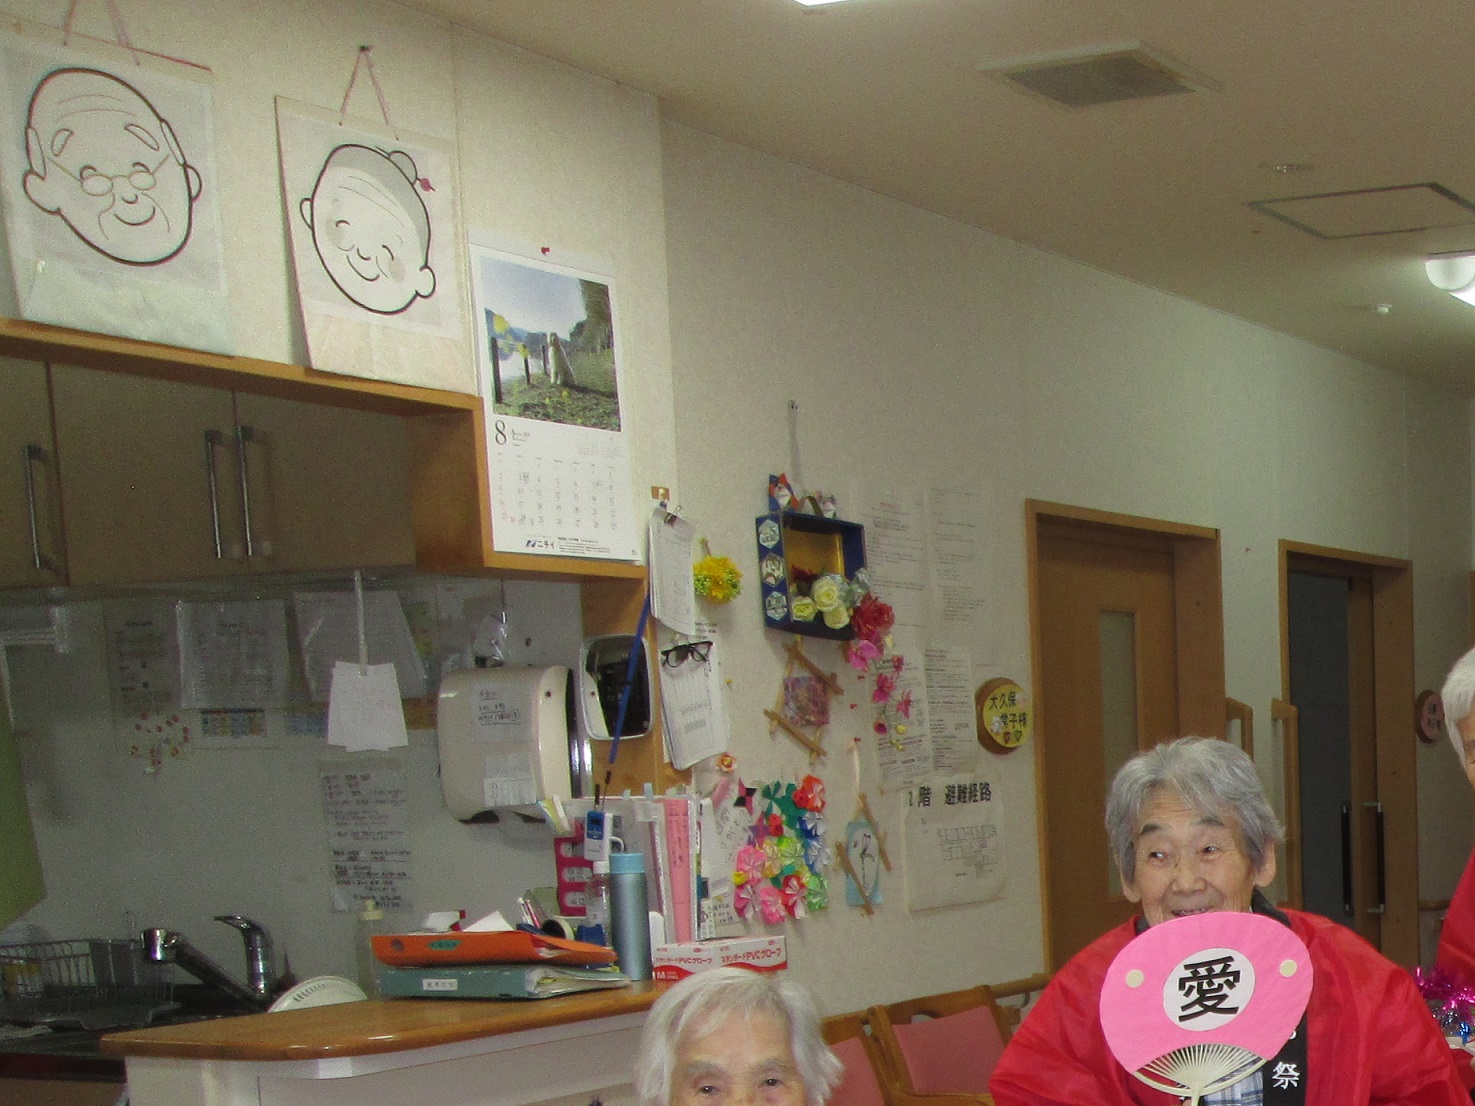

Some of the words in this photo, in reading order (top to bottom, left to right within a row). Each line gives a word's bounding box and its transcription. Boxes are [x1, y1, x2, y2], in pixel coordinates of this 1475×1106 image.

[494, 419, 507, 446] 8
[944, 781, 992, 805] 避難経路
[656, 971, 666, 980] M
[1177, 955, 1242, 1023] 愛
